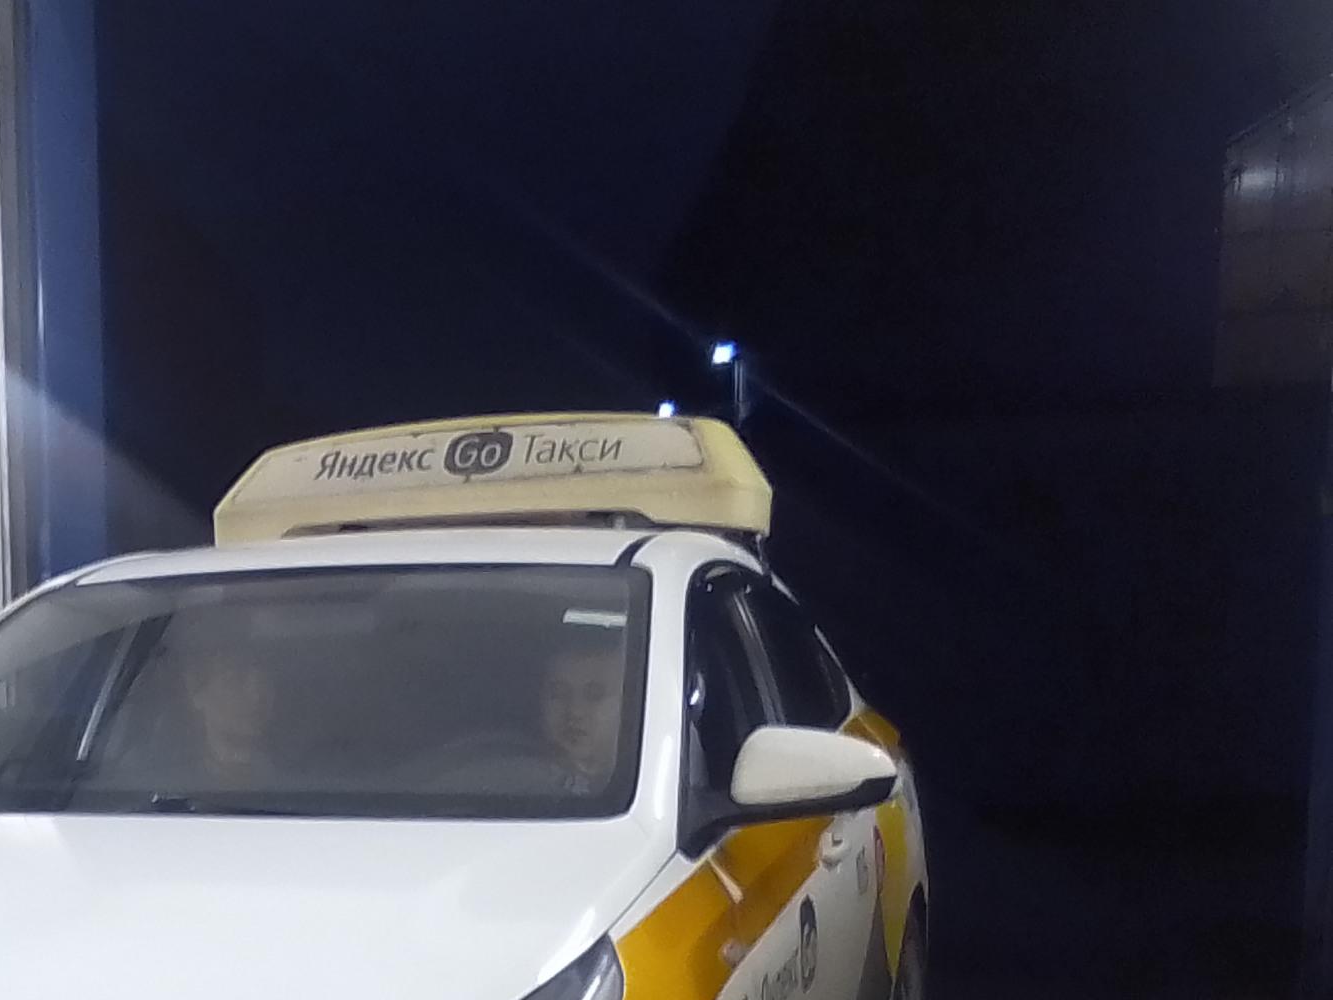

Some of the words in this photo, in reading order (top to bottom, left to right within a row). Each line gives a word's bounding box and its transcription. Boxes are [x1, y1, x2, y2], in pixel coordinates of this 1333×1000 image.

[313, 446, 434, 481] Яндекс
[453, 435, 502, 469] Go
[523, 434, 623, 465] Такси
